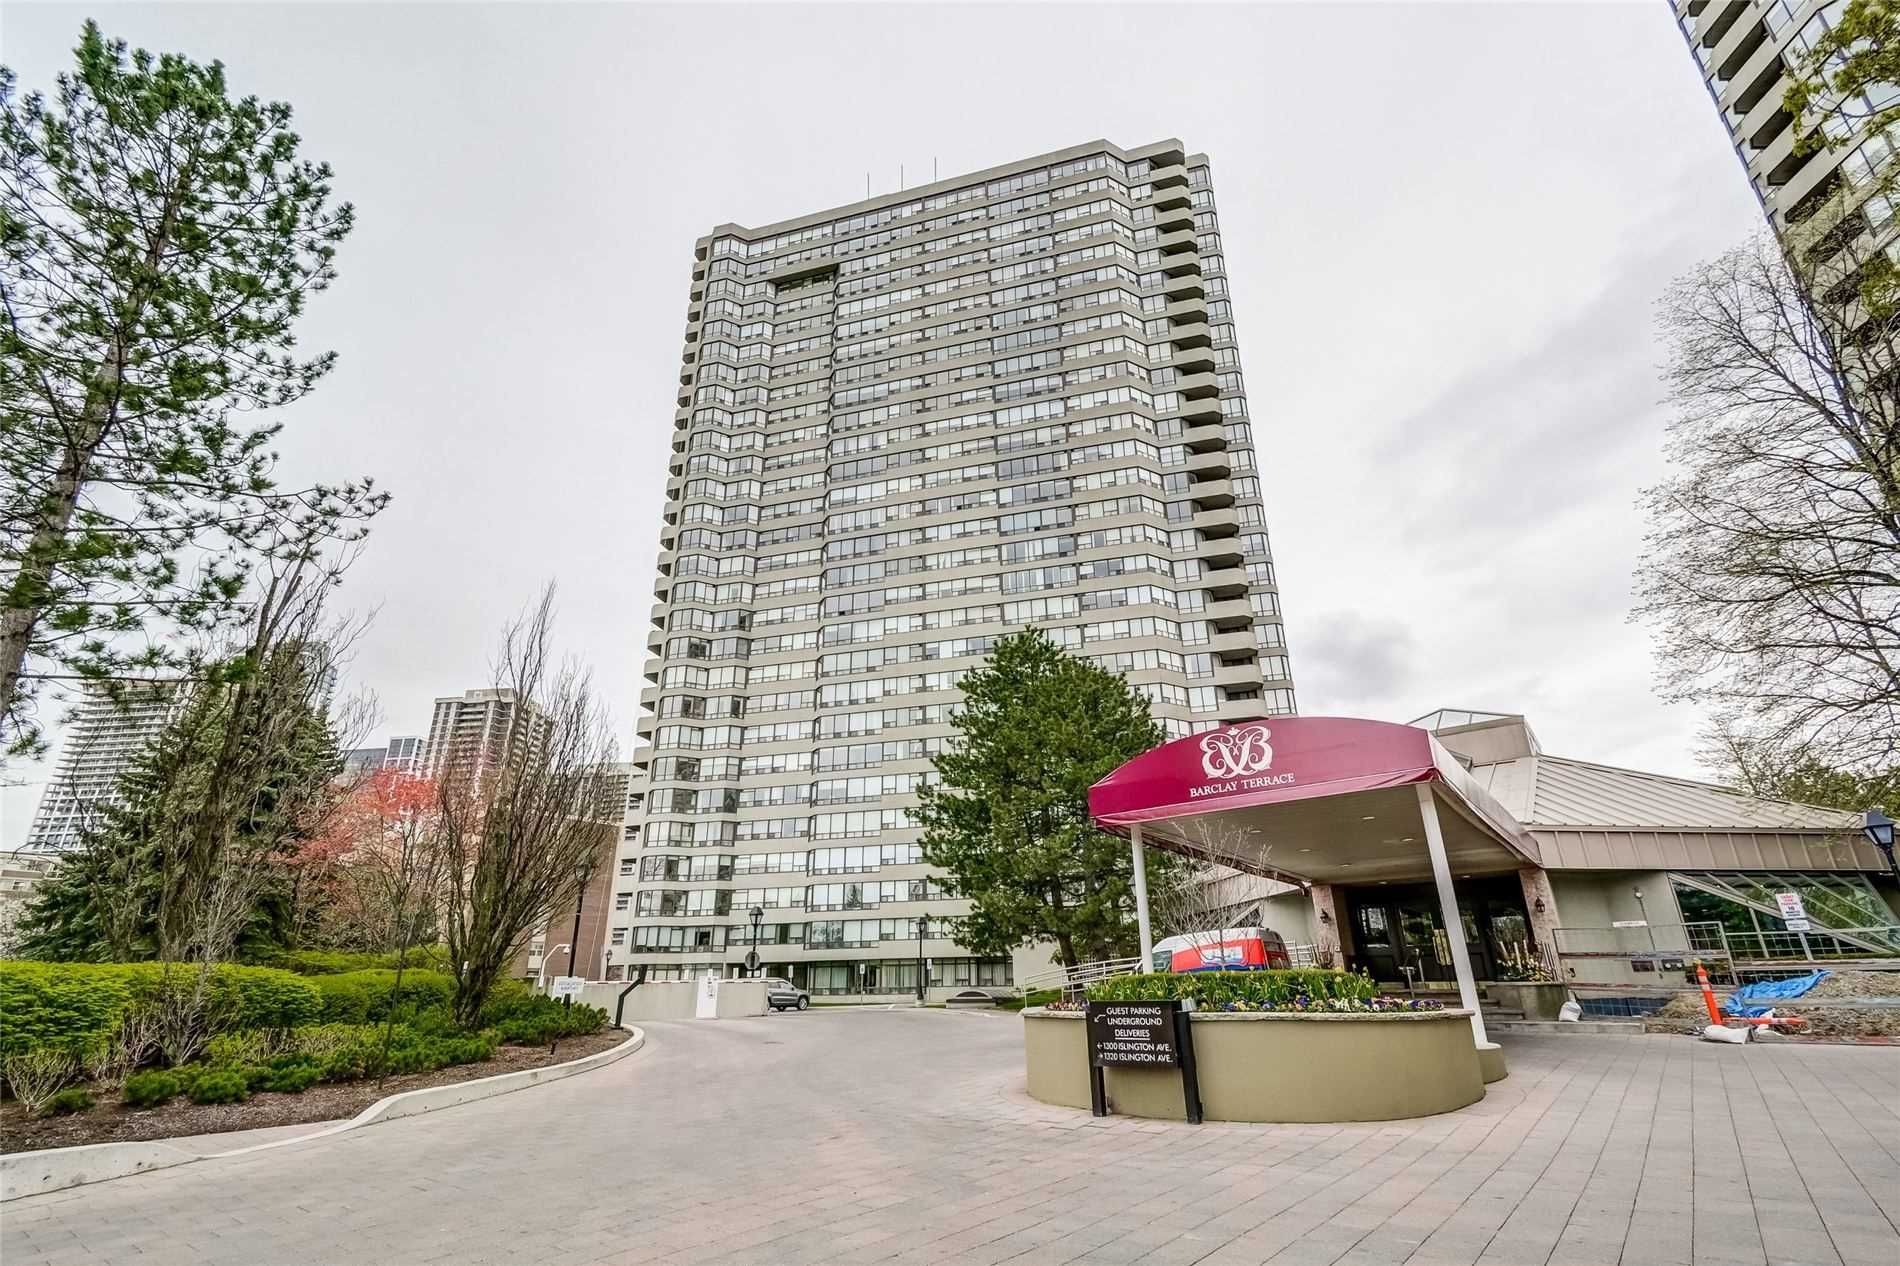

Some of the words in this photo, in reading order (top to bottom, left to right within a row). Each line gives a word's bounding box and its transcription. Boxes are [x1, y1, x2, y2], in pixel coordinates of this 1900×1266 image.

[1190, 780, 1238, 797] BARCLAY
[1241, 772, 1295, 789] TERRACE
[1106, 1007, 1128, 1015] GUEST
[1130, 1007, 1161, 1015] PARKING
[1107, 1017, 1162, 1025] UNDERGROUND
[1114, 1029, 1150, 1037] DELIVERIES
[1103, 1042, 1117, 1050] 1300
[1119, 1042, 1154, 1051] ISLINGTON
[1156, 1043, 1172, 1052] AVE.
[1104, 1052, 1118, 1060] 1320
[1119, 1052, 1155, 1062] ISLINGTON
[1157, 1054, 1173, 1063] AVE.
